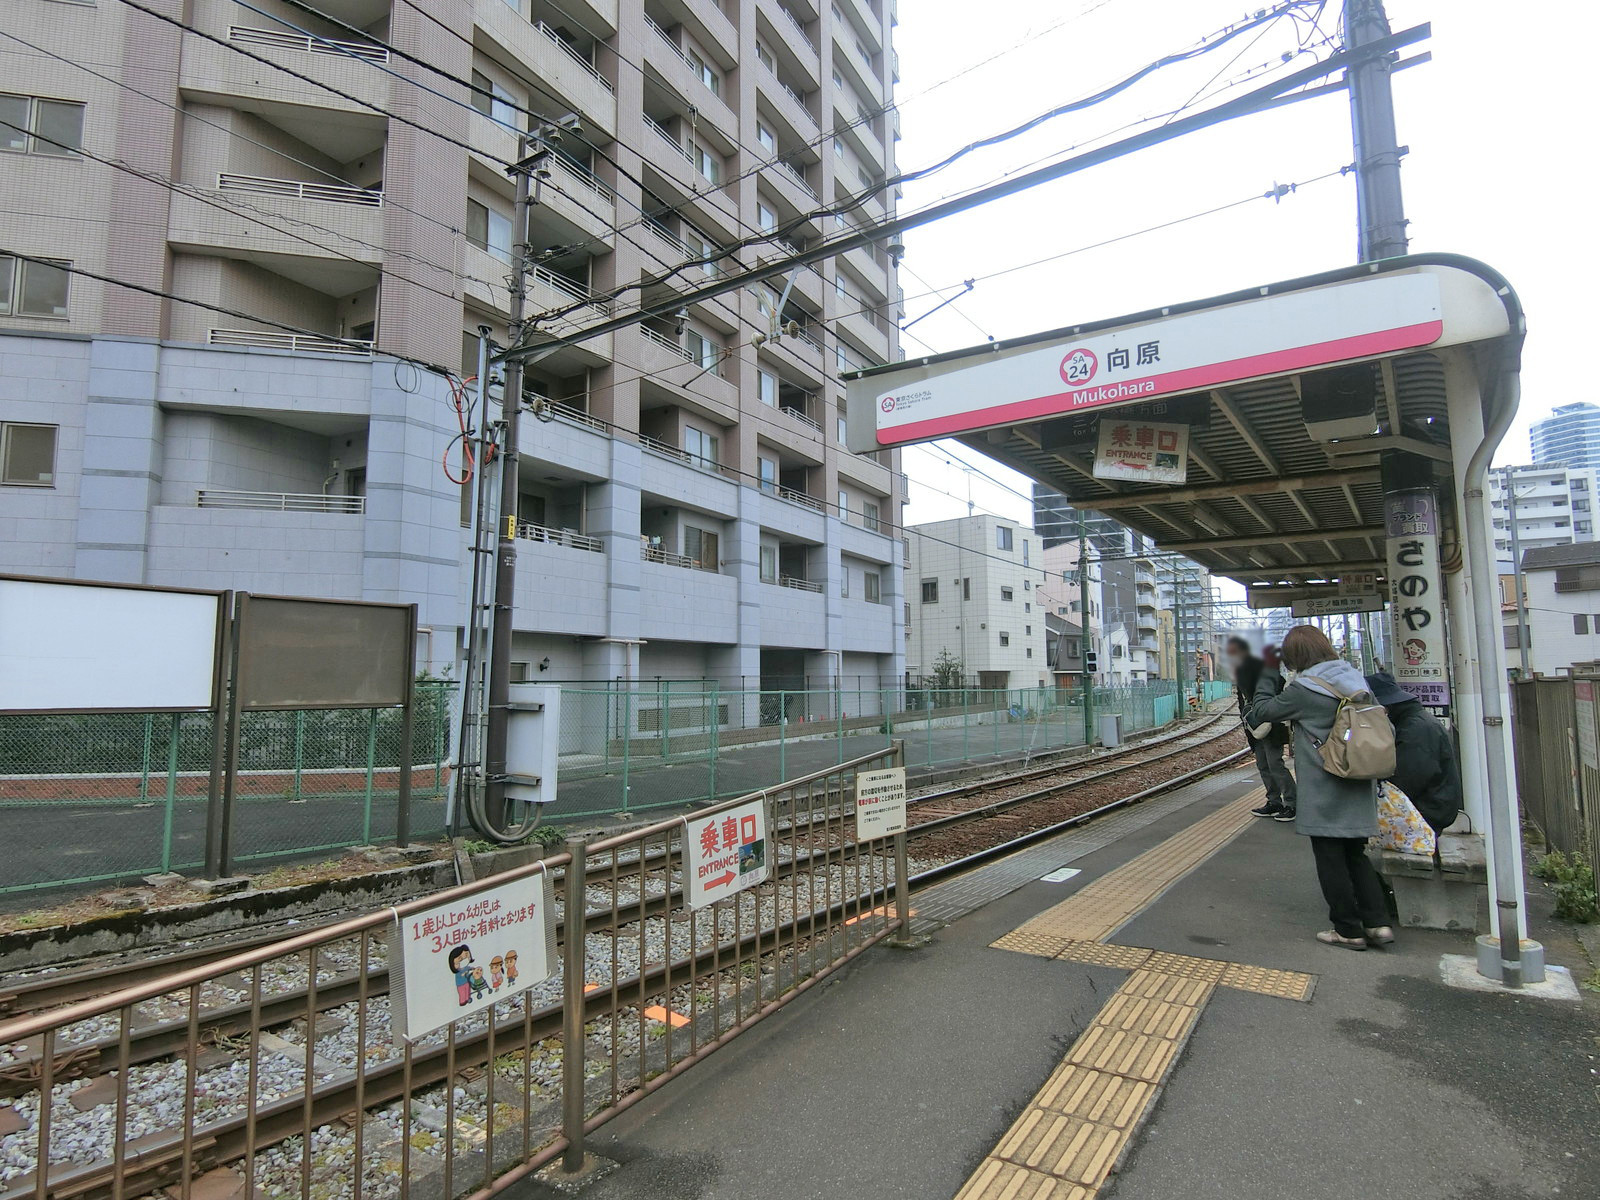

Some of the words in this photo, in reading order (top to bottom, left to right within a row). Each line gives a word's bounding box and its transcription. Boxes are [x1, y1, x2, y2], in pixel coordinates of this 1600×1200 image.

[1073, 355, 1085, 364] SA
[1107, 340, 1161, 373] 向原
[1069, 363, 1089, 379] 24
[884, 401, 892, 409] SA
[896, 391, 932, 402] 東京さくらトラム
[1073, 381, 1155, 405] Mukohara
[1111, 423, 1178, 452] 乗車口
[1105, 449, 1153, 461] ENTRANCE
[1396, 540, 1432, 632] さのや
[699, 814, 757, 859] 乗車口
[698, 852, 739, 878] ENTRANCE
[412, 899, 501, 941] 1歳以上の幼児は
[431, 902, 536, 954] 3人目から有料となります
